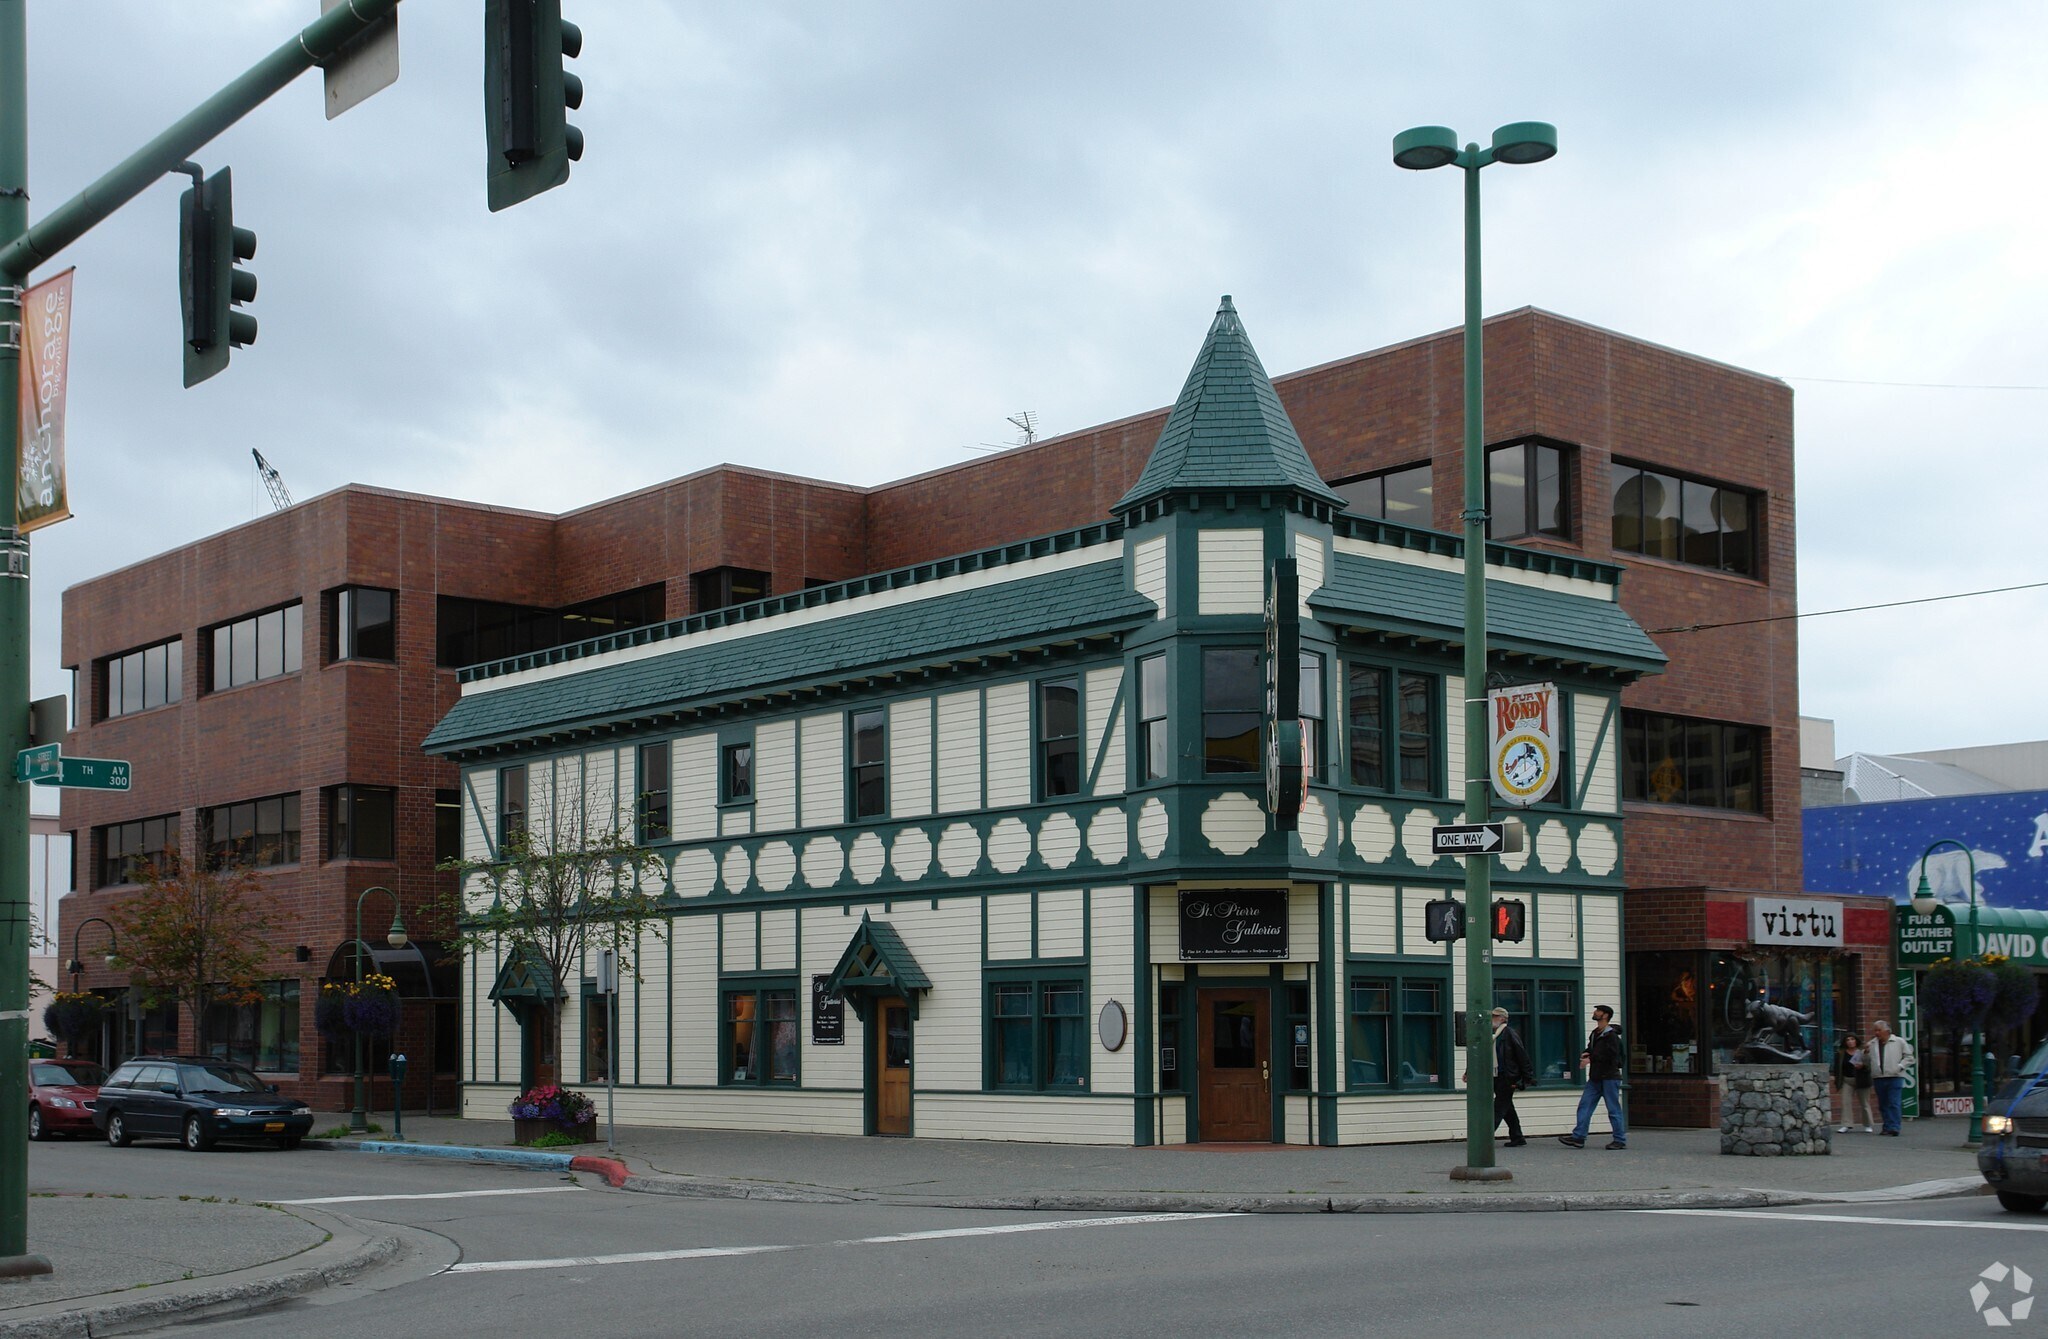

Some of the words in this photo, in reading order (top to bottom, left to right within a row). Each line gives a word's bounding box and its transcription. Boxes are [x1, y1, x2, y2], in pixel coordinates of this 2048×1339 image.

[54, 337, 63, 367] wild
[52, 373, 62, 398] big
[38, 292, 63, 507] anchorage
[1511, 693, 1534, 702] FUR
[1494, 690, 1552, 745] RONDY
[82, 765, 94, 775] TH
[112, 766, 125, 776] AV
[109, 776, 127, 786] 300
[1441, 834, 1460, 846] ONE
[1463, 833, 1483, 845] WAY
[1213, 901, 1260, 919] Pierre
[1762, 905, 1837, 938] virtu
[1908, 914, 1932, 925] FUR
[1935, 914, 1945, 925] &
[1221, 919, 1281, 944] Galleries
[1901, 927, 1953, 938] LEATHER
[1901, 940, 1953, 954] OUTLET
[1935, 1098, 1974, 1114] FACTOR
